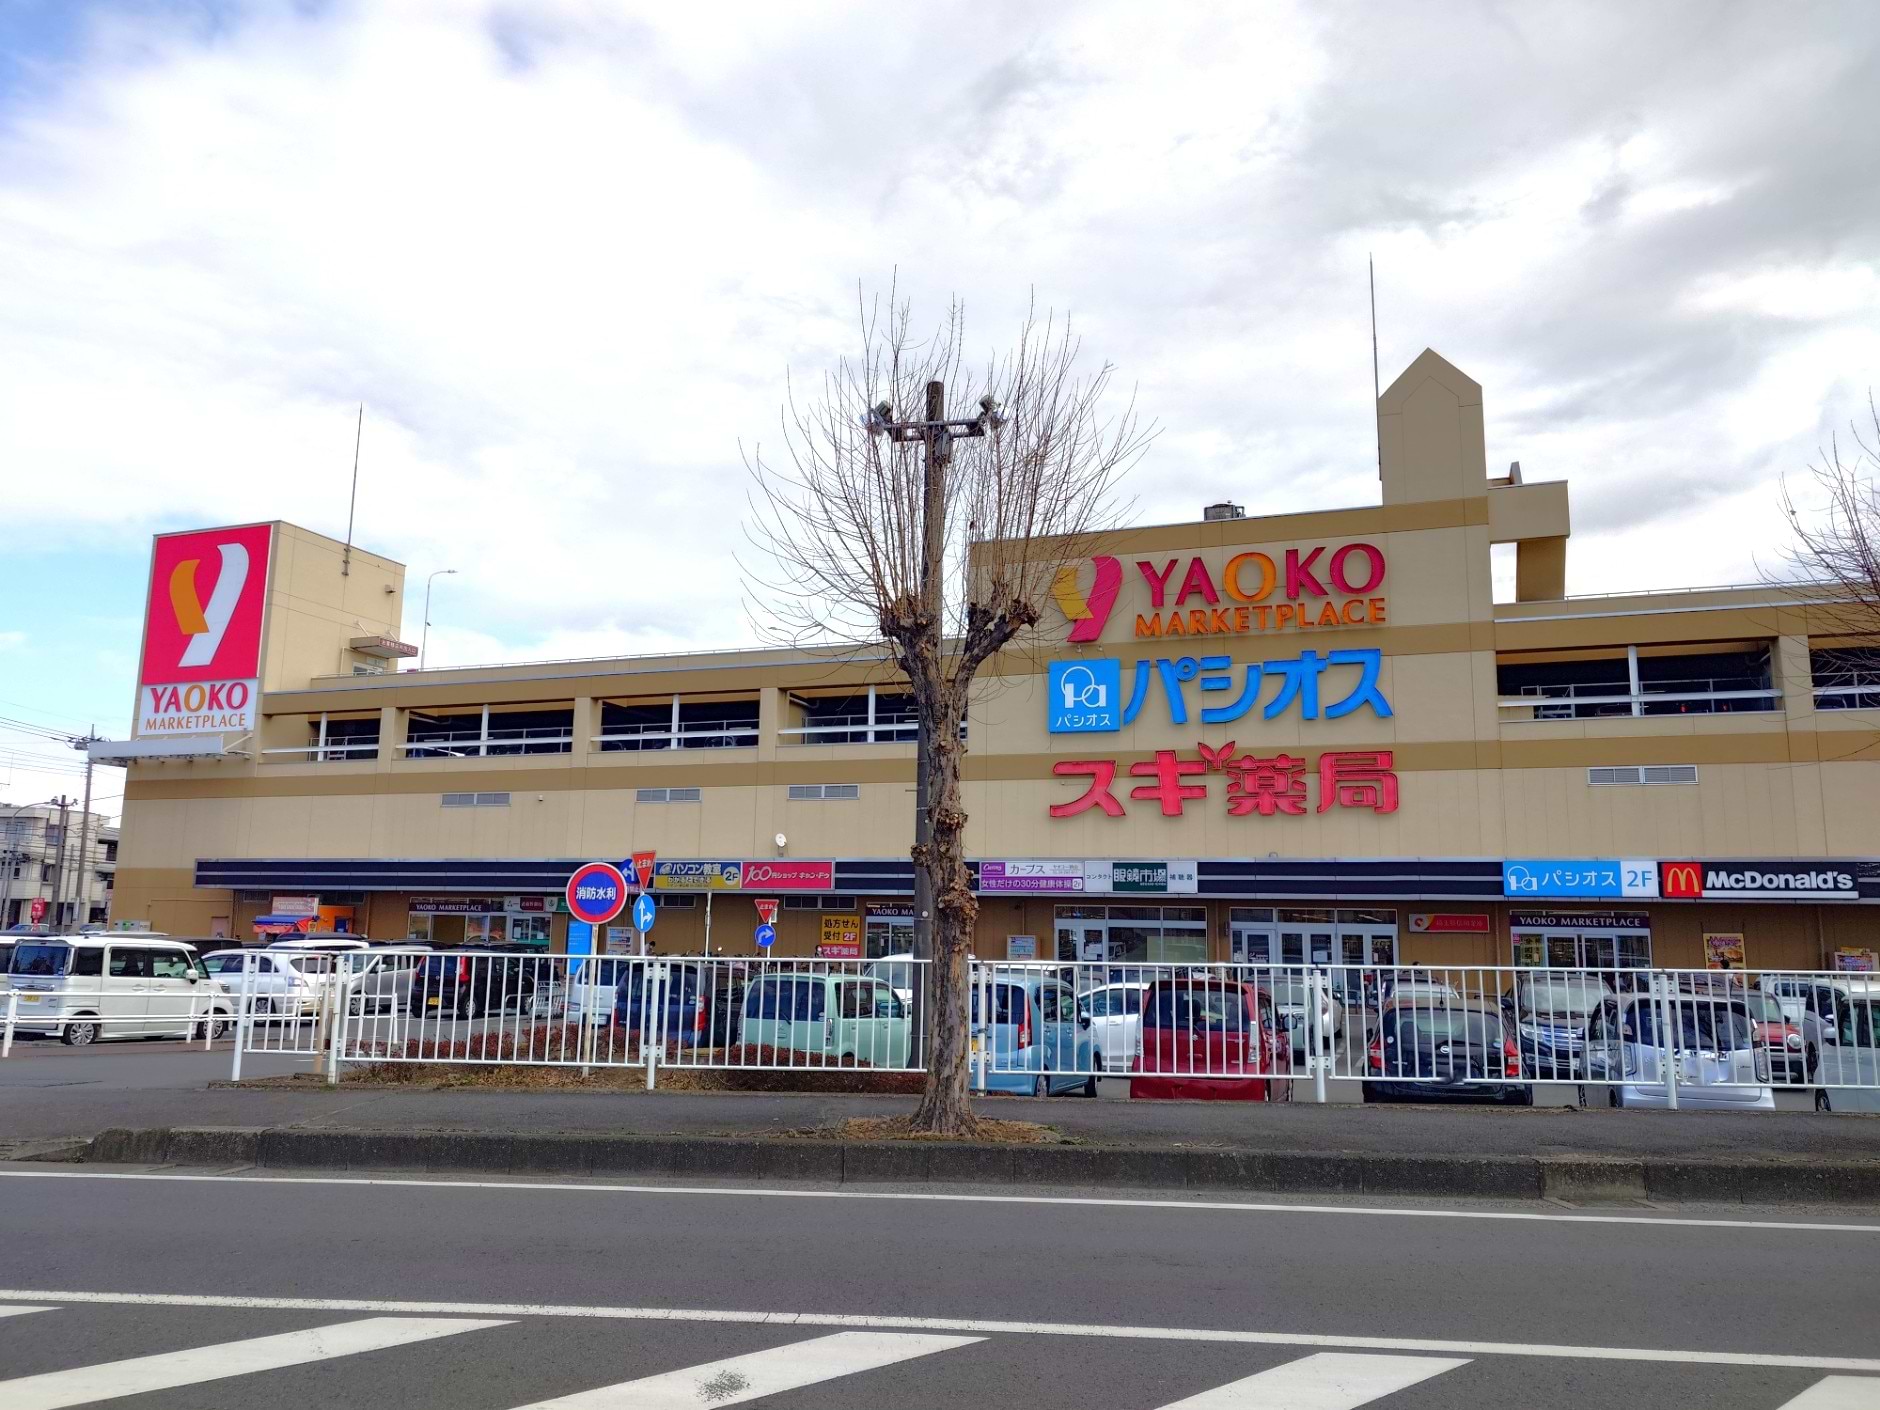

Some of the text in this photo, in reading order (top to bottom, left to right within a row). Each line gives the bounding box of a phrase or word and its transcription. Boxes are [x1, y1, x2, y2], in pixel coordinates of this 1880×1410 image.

[1136, 543, 1386, 608] YAOKO
[1135, 598, 1386, 638] MARKETPLACE
[1123, 648, 1393, 725] パシオス
[150, 682, 248, 714] YAOKO
[145, 713, 246, 731] MARKETPLACE
[1056, 714, 1111, 728] パシオス
[1050, 741, 1399, 817] スギ薬局
[672, 863, 721, 875] パソコン教室
[725, 871, 738, 881] 2F
[1010, 864, 1045, 874] カーブス
[1114, 868, 1167, 882] 眼鏡市場
[1542, 870, 1616, 886] パシオス
[1627, 870, 1652, 887] 2F
[1706, 871, 1853, 889] McDonald's
[576, 886, 616, 900] 消防水利
[439, 904, 482, 912] MARKETPLACE
[824, 919, 858, 928] 処方せん
[1520, 917, 1640, 926] YAOKO MARKETPLACE
[823, 931, 857, 941] 受付 2F
[823, 945, 858, 956] スギ薬局
